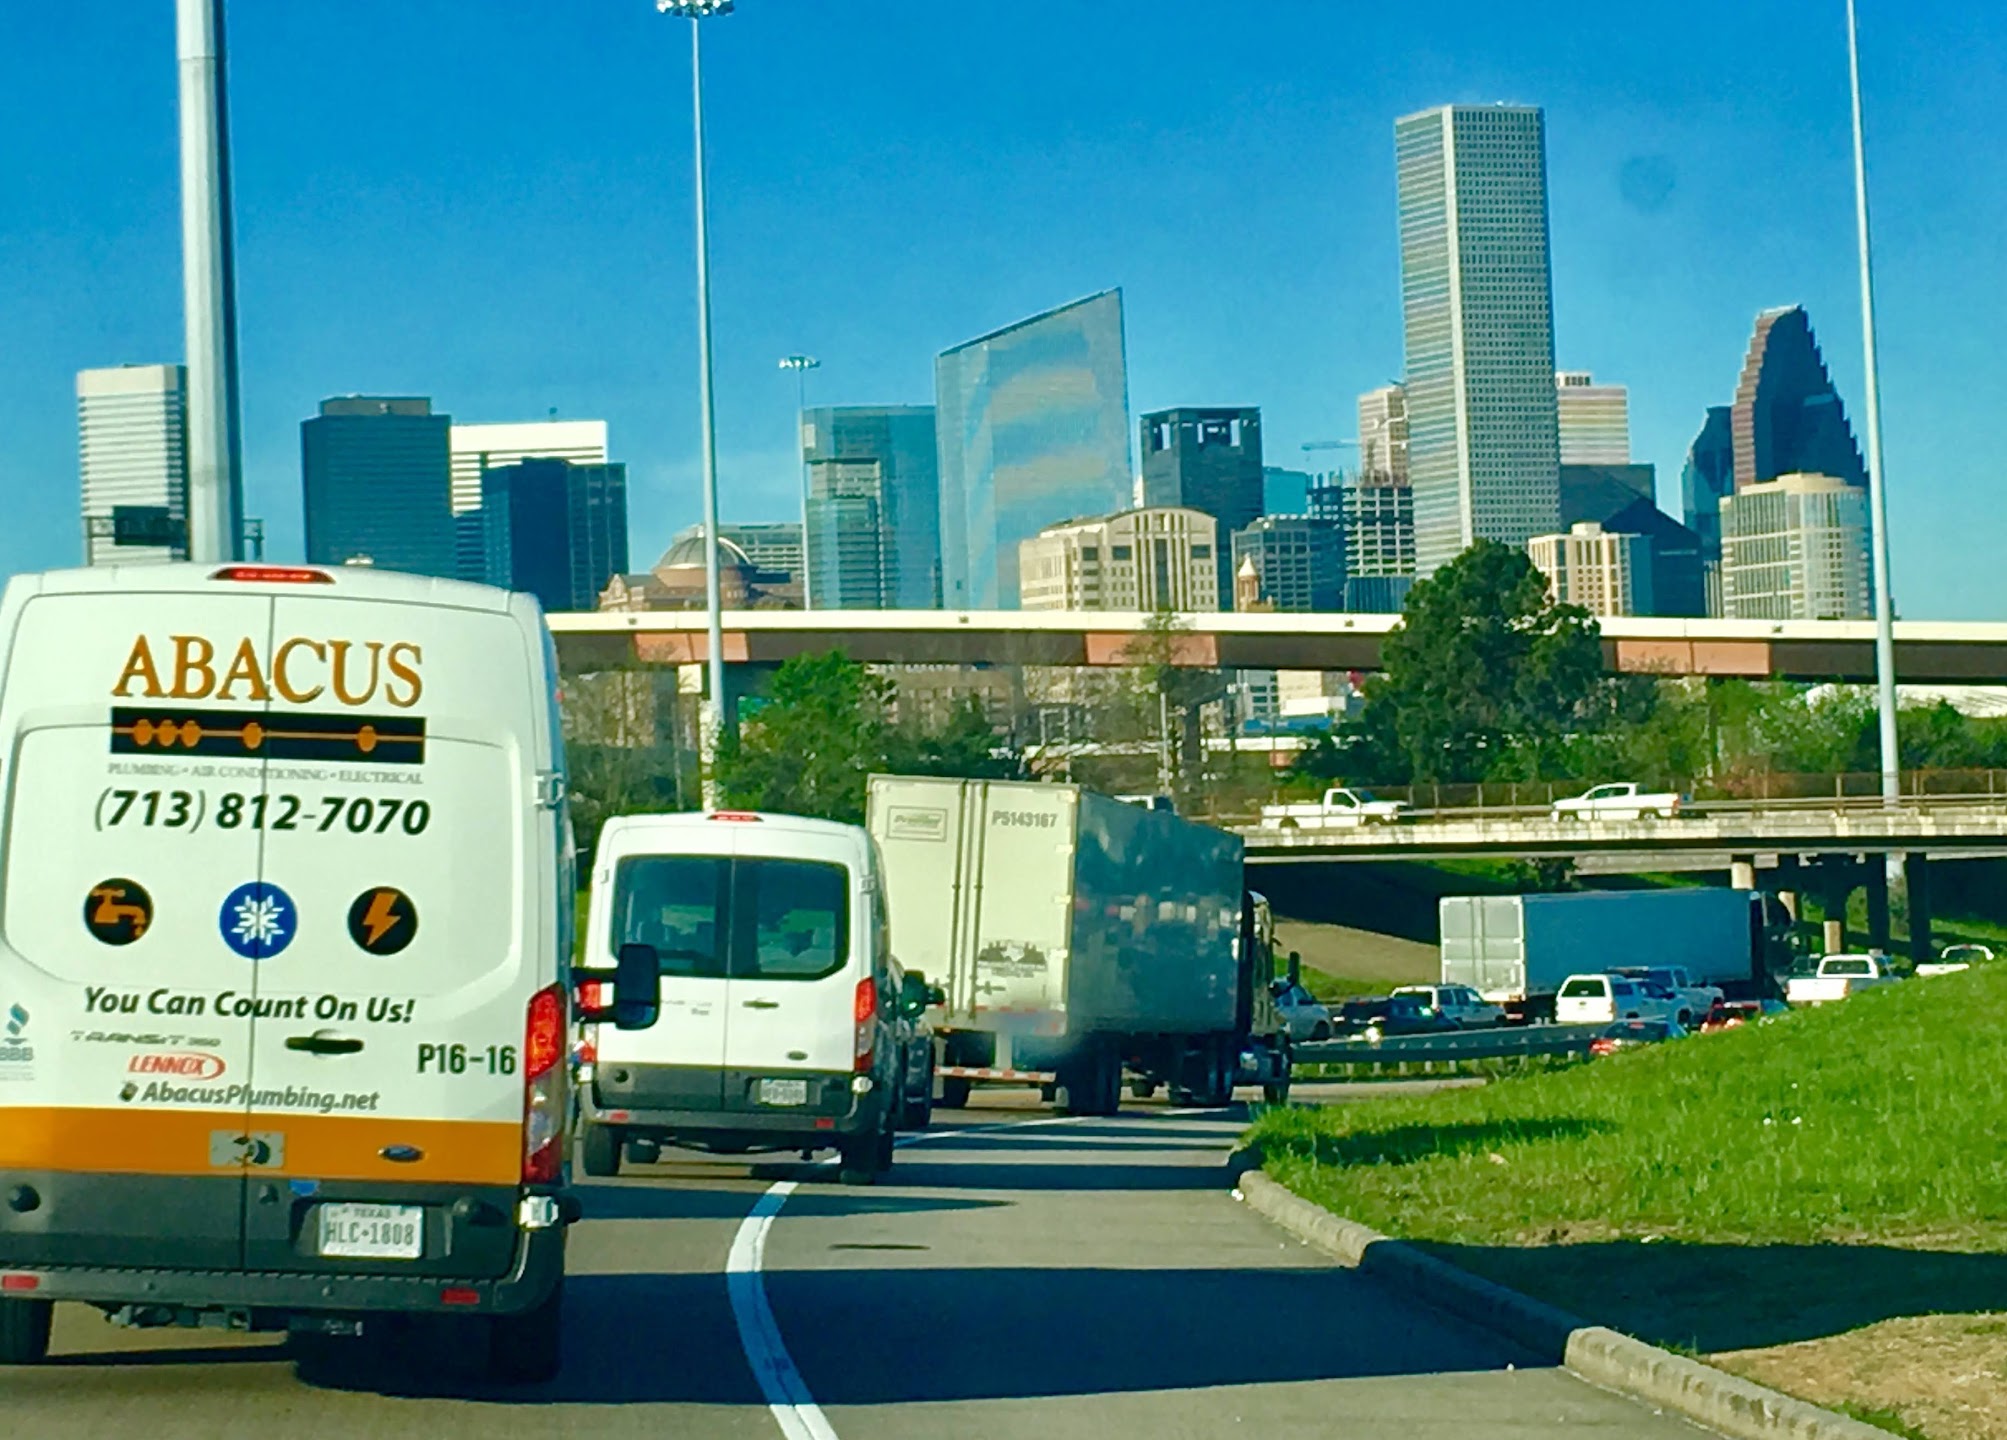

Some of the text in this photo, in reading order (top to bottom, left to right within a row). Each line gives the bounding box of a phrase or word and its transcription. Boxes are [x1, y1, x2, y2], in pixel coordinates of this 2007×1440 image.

[111, 634, 423, 708] ABACUS
[108, 763, 424, 784] PLUMBING AIR CONDITIONING ELECTRICAL
[95, 786, 431, 836] (713) 812-7070
[85, 986, 416, 1023] You Can Count On Us!
[128, 1055, 205, 1076] LENNOX
[416, 1043, 517, 1075] P16-16
[141, 1080, 380, 1114] AbacusPlumbing.net
[354, 1207, 392, 1219] TEXAS
